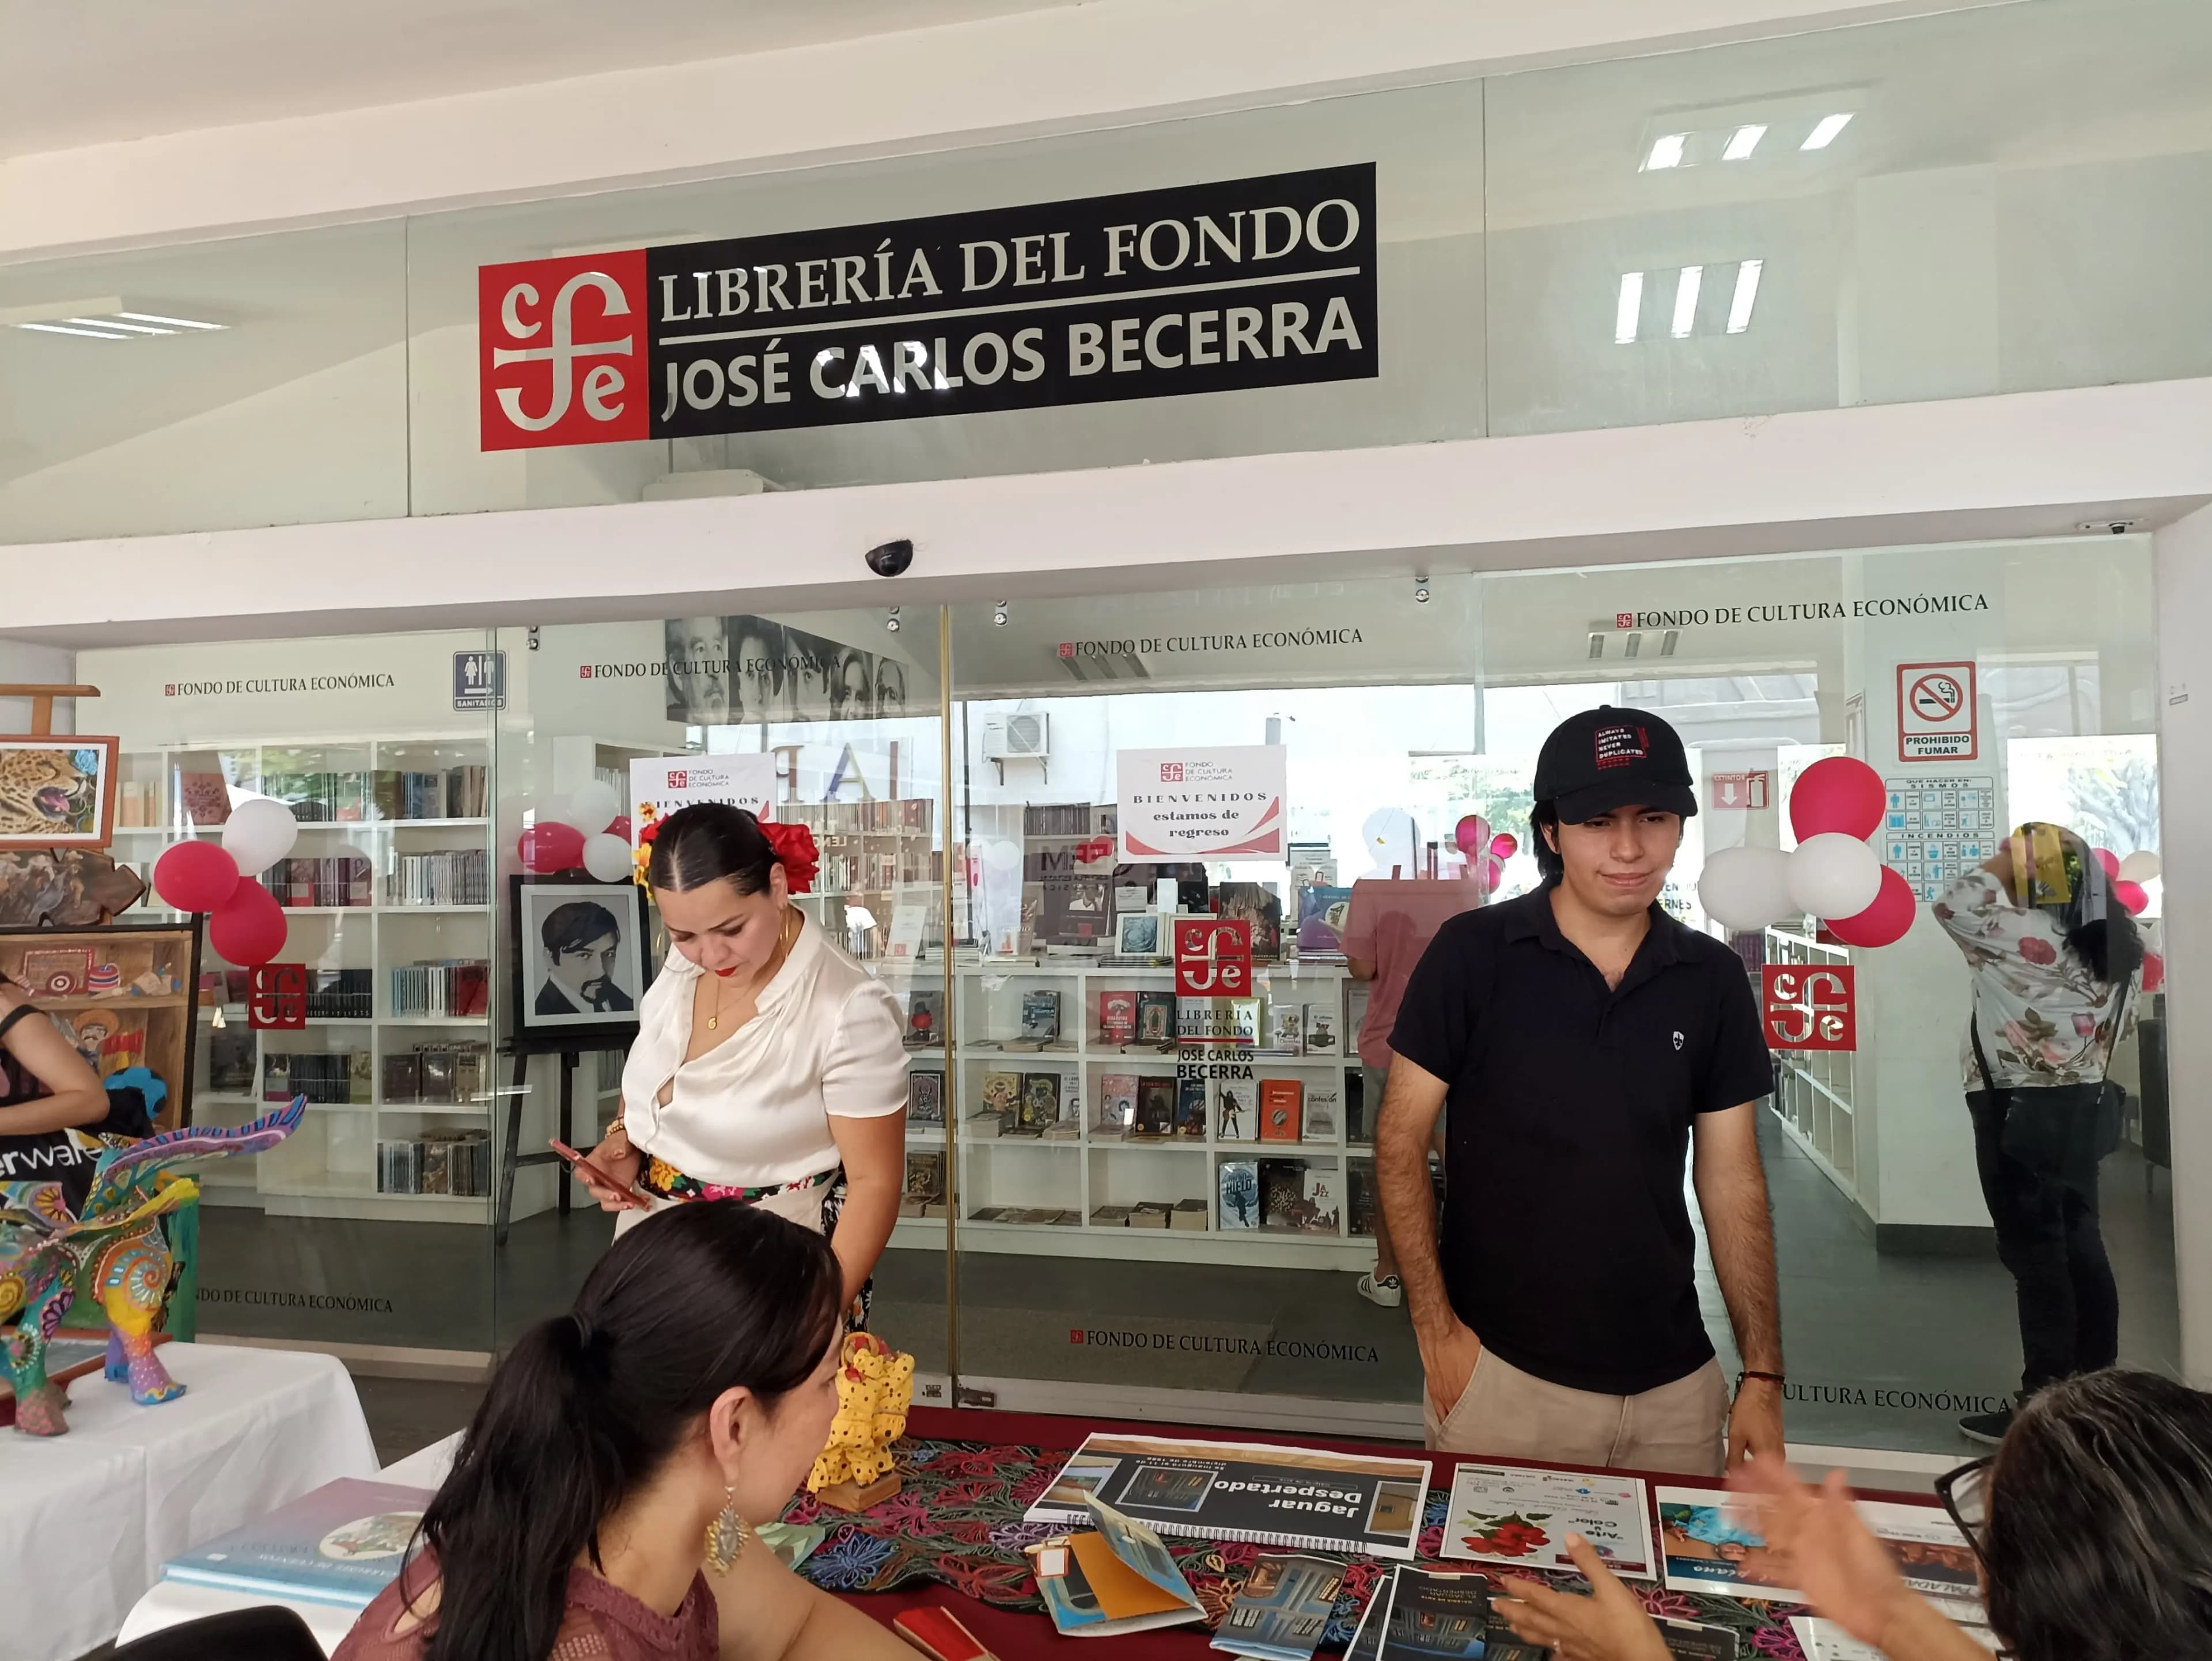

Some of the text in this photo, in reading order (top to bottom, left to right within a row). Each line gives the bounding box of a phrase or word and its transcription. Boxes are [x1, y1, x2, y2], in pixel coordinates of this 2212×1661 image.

[658, 198, 1361, 322] LIBRERÍA DEL FONDO
[661, 296, 1363, 423] JOSÉ CARLOS BECERRA
[1637, 593, 1989, 627] FONDO DE CULTURA ECONÓMICA
[1075, 627, 1363, 656] FONDO DE CULTURA ECONÓMICA
[595, 653, 841, 678] FONDO DE CULTURA ECONÓMICA
[177, 672, 395, 696] FONDO DE CULTURA ECONÓMICA
[1598, 728, 1624, 737] ALWAYS
[1598, 734, 1632, 744] IMITATED
[1599, 742, 1621, 751] NEVER
[1906, 735, 1969, 746] PROHIBIDO
[1599, 748, 1643, 759] DUPLICATED
[1918, 746, 1958, 755] FUMAR
[1134, 792, 1267, 804] BIENVENIDOS
[1153, 809, 1239, 820] estamos de
[1169, 828, 1229, 839] regreso
[1176, 1006, 1253, 1020] LIBRERÍA
[1177, 1026, 1253, 1036] DEL FONDO
[1208, 1050, 1254, 1062] CARLOS
[1176, 1065, 1253, 1079] BECERRA
[224, 1289, 242, 1303] DE
[245, 1291, 305, 1307] CULTURA
[309, 1292, 393, 1313] ECONÓMICA
[1087, 1330, 1378, 1362] FONDO DE CULTURA ECONÓMICA
[1783, 1383, 2010, 1414] ULTURA ECONÓMICA
[1214, 1481, 1362, 1503] Despertado
[1268, 1499, 1359, 1518] Jaguar
